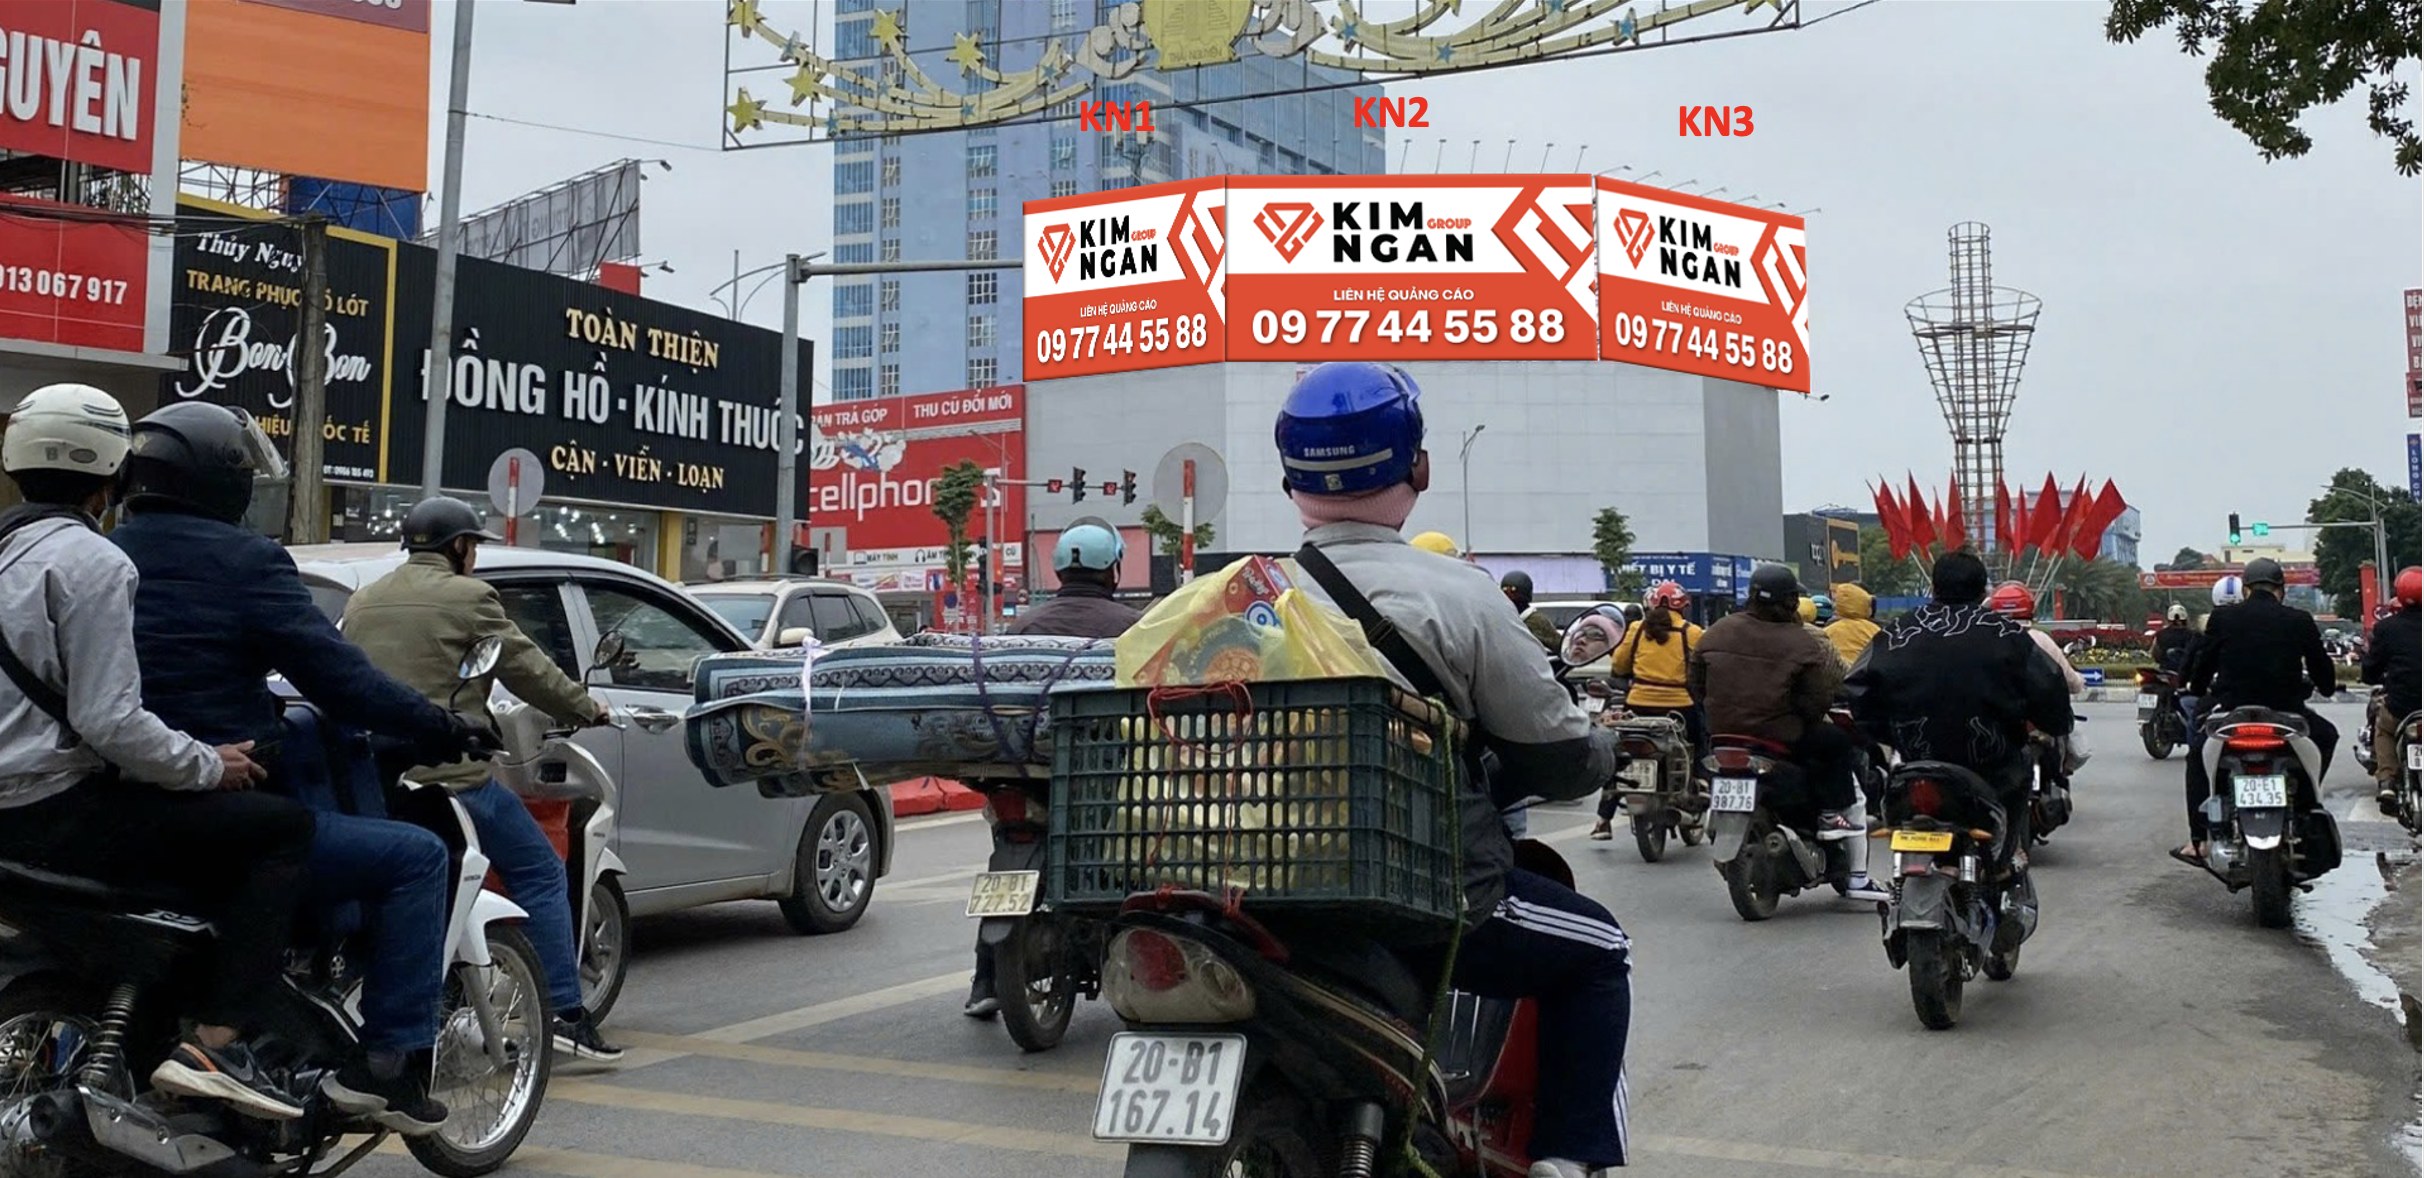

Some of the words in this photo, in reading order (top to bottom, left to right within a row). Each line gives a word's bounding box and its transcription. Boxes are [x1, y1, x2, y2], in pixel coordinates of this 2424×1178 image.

[0, 29, 141, 141] UYÊN
[1080, 215, 1130, 249] KIM
[1131, 228, 1157, 242] GROUP
[1333, 202, 1423, 230] KIM
[1427, 218, 1472, 230] GROUP
[197, 231, 250, 262] Thủy
[1333, 234, 1473, 263] NGAN
[1659, 215, 1712, 252] KIM
[1713, 242, 1740, 257] GROUP
[1080, 244, 1158, 281] NGAN
[1660, 248, 1742, 288] NGAN
[37, 270, 80, 298] 067
[86, 277, 127, 304] 917
[187, 269, 251, 298] TRANG
[336, 293, 369, 317] LÓT
[1333, 288, 1363, 301] LIÊN
[1367, 287, 1385, 303] HỆ
[1388, 286, 1439, 301] QUẢNG
[1442, 287, 1474, 301] CÁO
[1080, 303, 1097, 318] LIÊN
[1098, 302, 1108, 317] HỆ
[1109, 300, 1137, 316] QUẢNG
[1138, 298, 1157, 312] CÁO
[1661, 299, 1679, 315] LIÊN
[1681, 301, 1692, 318] HỆ
[1693, 303, 1720, 322] QUẢNG
[1721, 308, 1742, 325] CÁO
[566, 307, 638, 352] TOÀN
[648, 330, 720, 374] THIỆN
[1037, 328, 1066, 364] 09
[1139, 316, 1169, 352] 55
[1176, 312, 1207, 349] 88
[1252, 309, 1307, 344] 09
[1444, 309, 1498, 344] 55
[1510, 308, 1565, 344] 88
[1615, 312, 1648, 349] 09
[1725, 331, 1756, 367] 55
[1762, 340, 1793, 374] 88
[176, 306, 287, 398] Bon
[563, 352, 609, 424] HỒ
[635, 375, 708, 441] KÍNH
[914, 404, 938, 418] THU
[942, 397, 960, 418] CŨ
[962, 388, 985, 414] ĐỔI
[988, 391, 1012, 411] MỚI
[324, 415, 347, 441] ỐC
[352, 420, 370, 444] TẾ
[835, 404, 859, 427] TRẢ
[861, 403, 888, 424] GÓP
[551, 440, 595, 480] CẬN
[615, 445, 661, 483] VIỄN
[678, 462, 724, 493] LOẠN
[1304, 445, 1355, 458] SAMSUNG
[810, 467, 1001, 521] ellphonS
[1667, 564, 1676, 575] Y
[1678, 561, 1696, 576] TẾ
[2243, 779, 2276, 792] 20-E1
[981, 874, 1027, 893] 20-B1
[1122, 1041, 1223, 1085] 20-B1
[1108, 1090, 1221, 1138] 167.14
